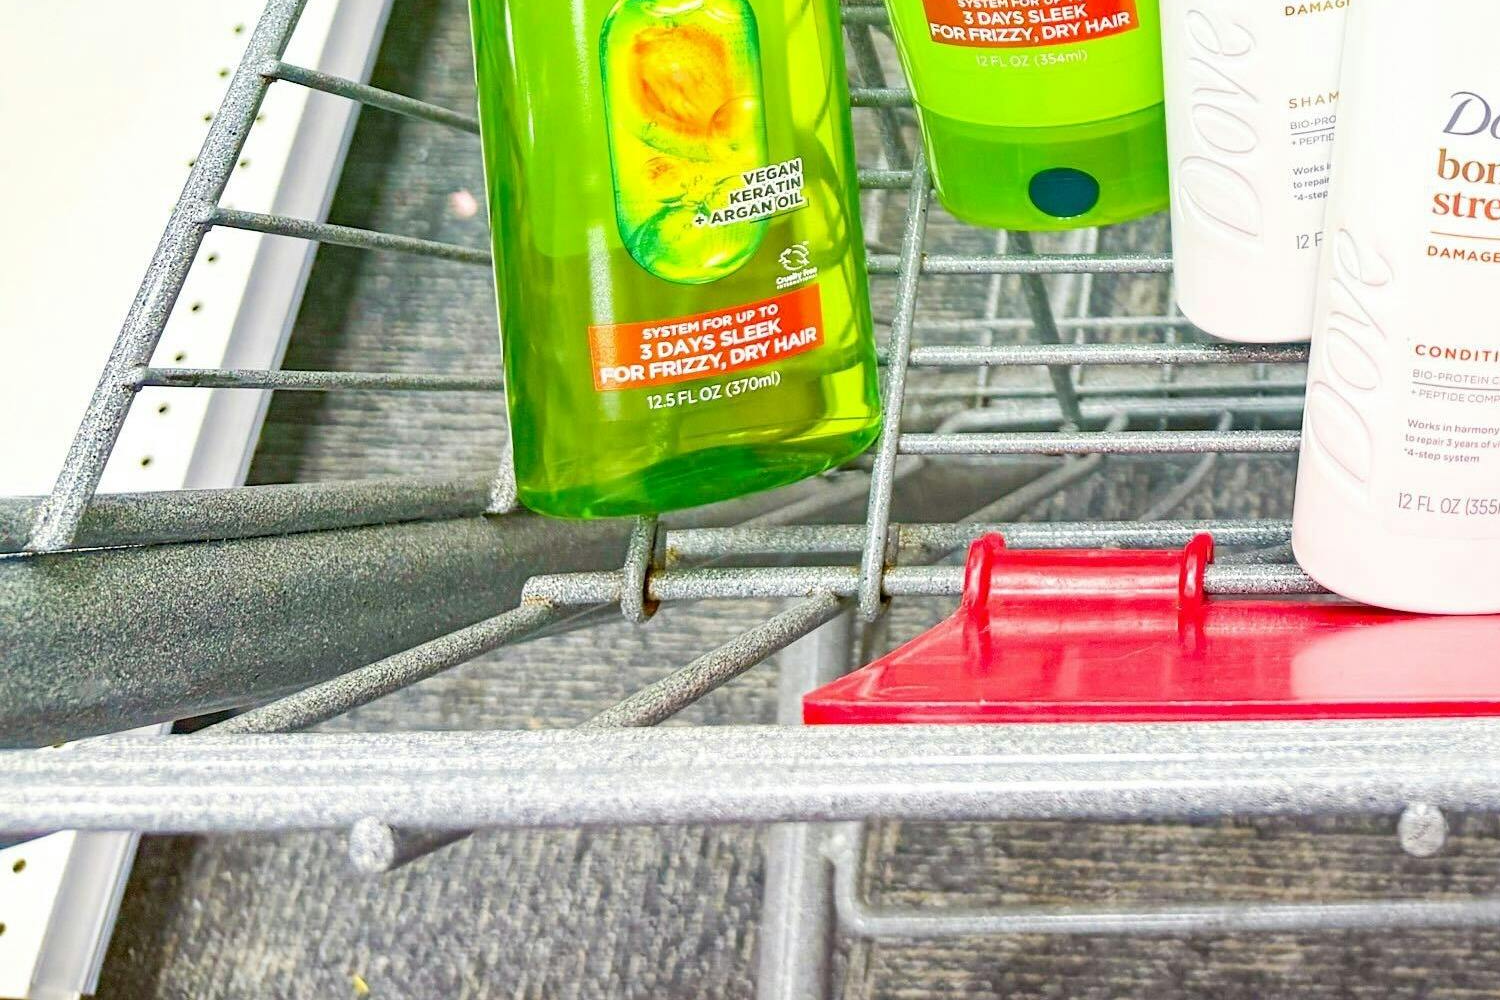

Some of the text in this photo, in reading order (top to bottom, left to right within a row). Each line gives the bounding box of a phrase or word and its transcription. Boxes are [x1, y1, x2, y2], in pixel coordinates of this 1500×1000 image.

[963, 3, 1089, 26] 3 DAYS SLEEK
[929, 11, 1131, 44] FOR FRIZZY, DRY HAIR
[743, 160, 801, 186] VEGAN
[1293, 164, 1325, 176] Works
[730, 176, 802, 205] KERATIN
[711, 194, 804, 225] ARGAN OIL
[642, 303, 779, 341] SYSTEM FOR UP TO
[640, 317, 783, 361] 3 DAYS SLEEK
[600, 325, 817, 385] FOR FRIZZY, DRY HAIR
[647, 370, 782, 410] 12.5 FL OZ (370ml)
[1412, 369, 1490, 386] BIO-PROTEIN
[1419, 389, 1465, 403] PEPTIDE
[1407, 418, 1441, 432] Works
[1454, 424, 1500, 436] harmony
[1416, 436, 1445, 450] repair
[1454, 440, 1480, 450] years
[1443, 452, 1480, 464] system
[1398, 492, 1412, 510] 12
[1416, 495, 1436, 513] FL
[1440, 498, 1463, 516] OZ
